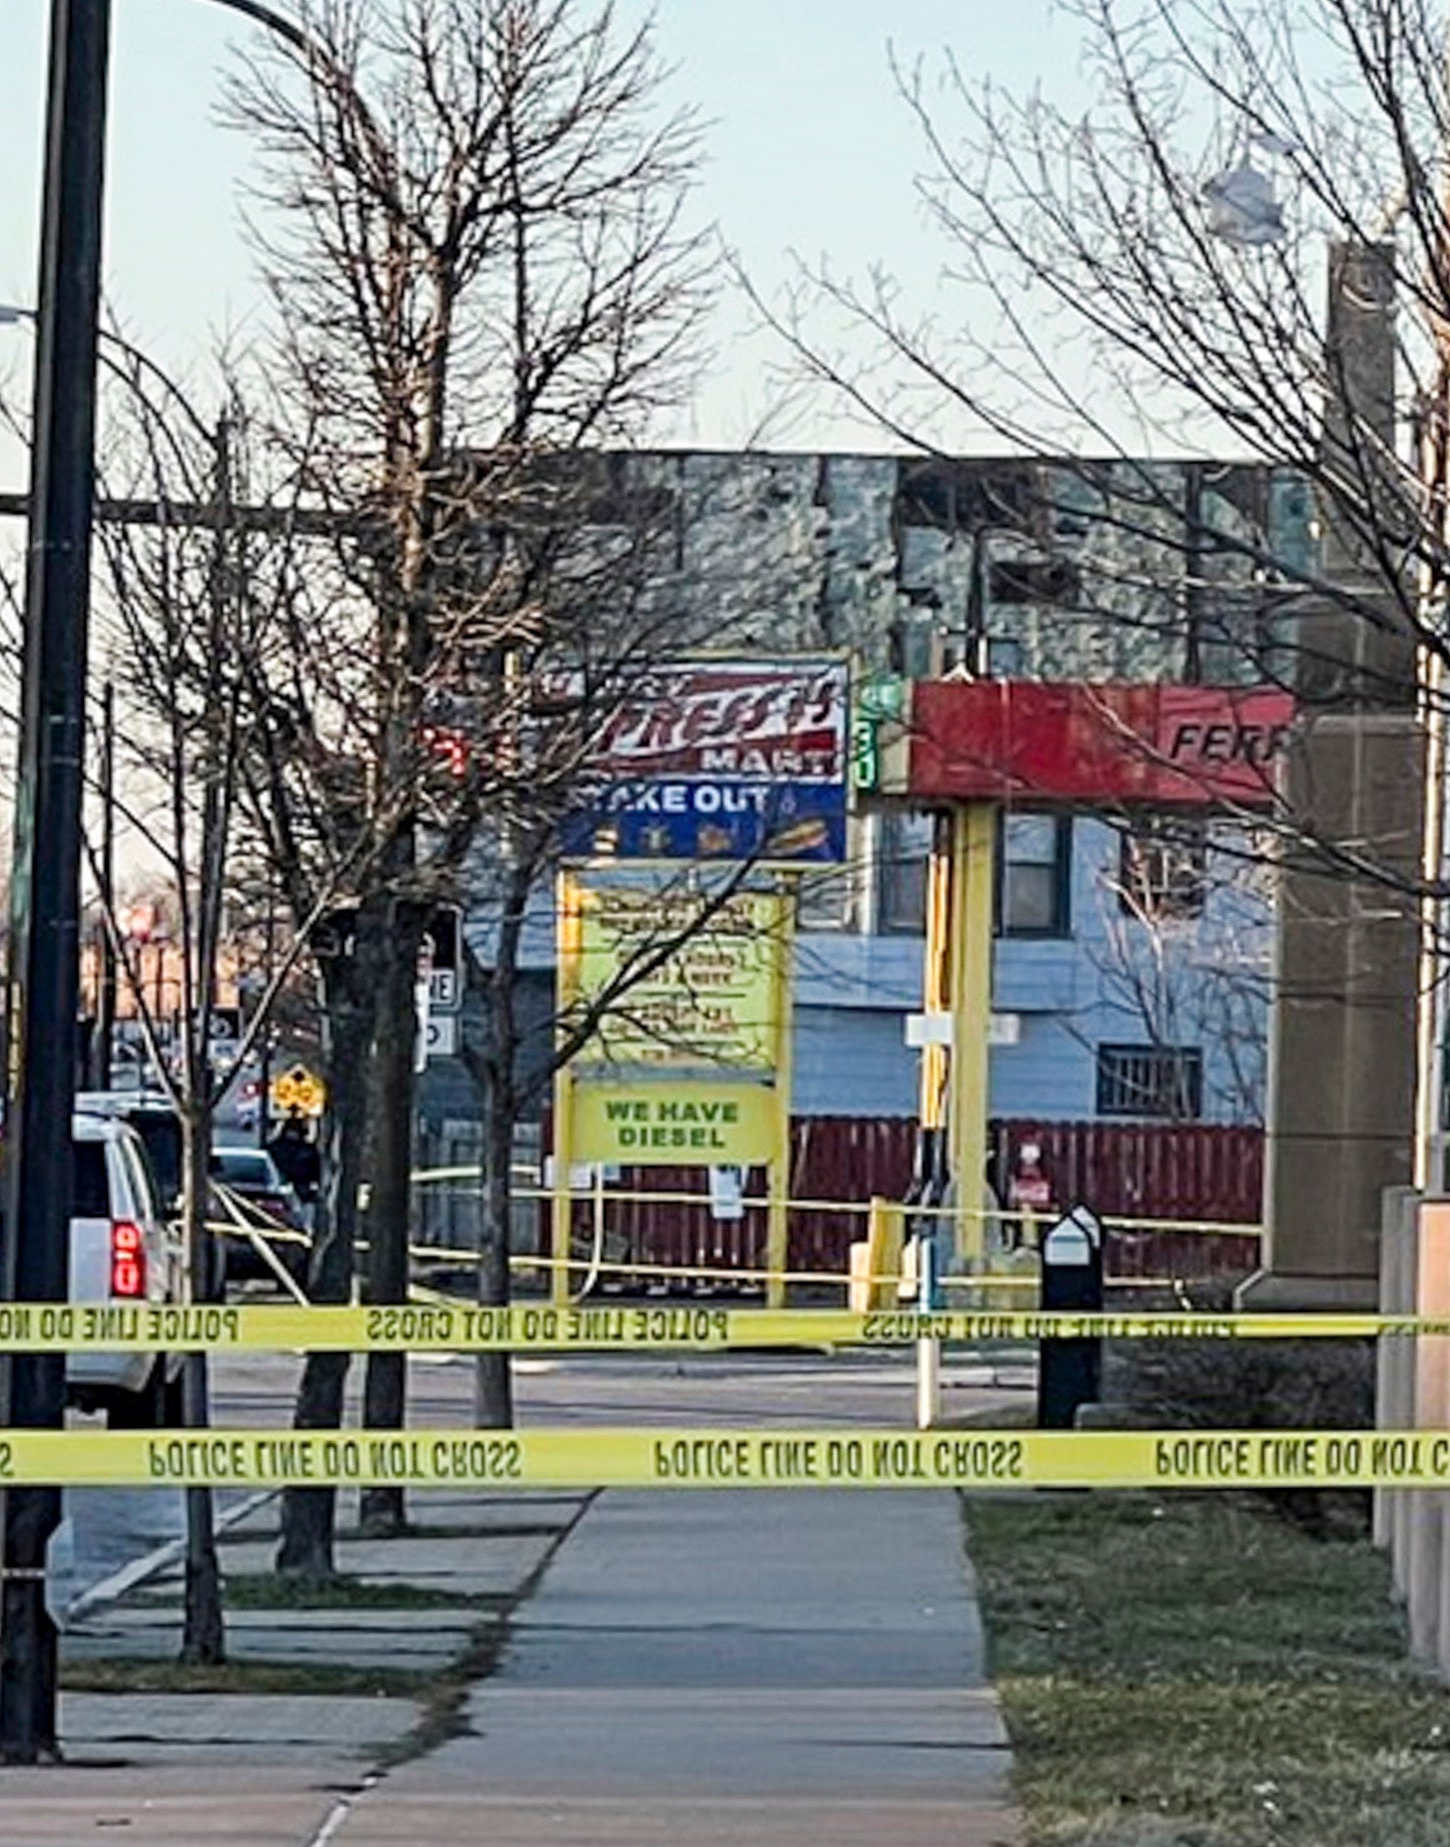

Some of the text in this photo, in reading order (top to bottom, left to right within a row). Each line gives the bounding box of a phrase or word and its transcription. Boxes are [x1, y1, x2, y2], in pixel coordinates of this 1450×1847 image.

[703, 749, 831, 775] MART
[695, 784, 770, 813] OUT
[606, 1101, 739, 1123] WE HAVE
[619, 1127, 726, 1149] DIESEL
